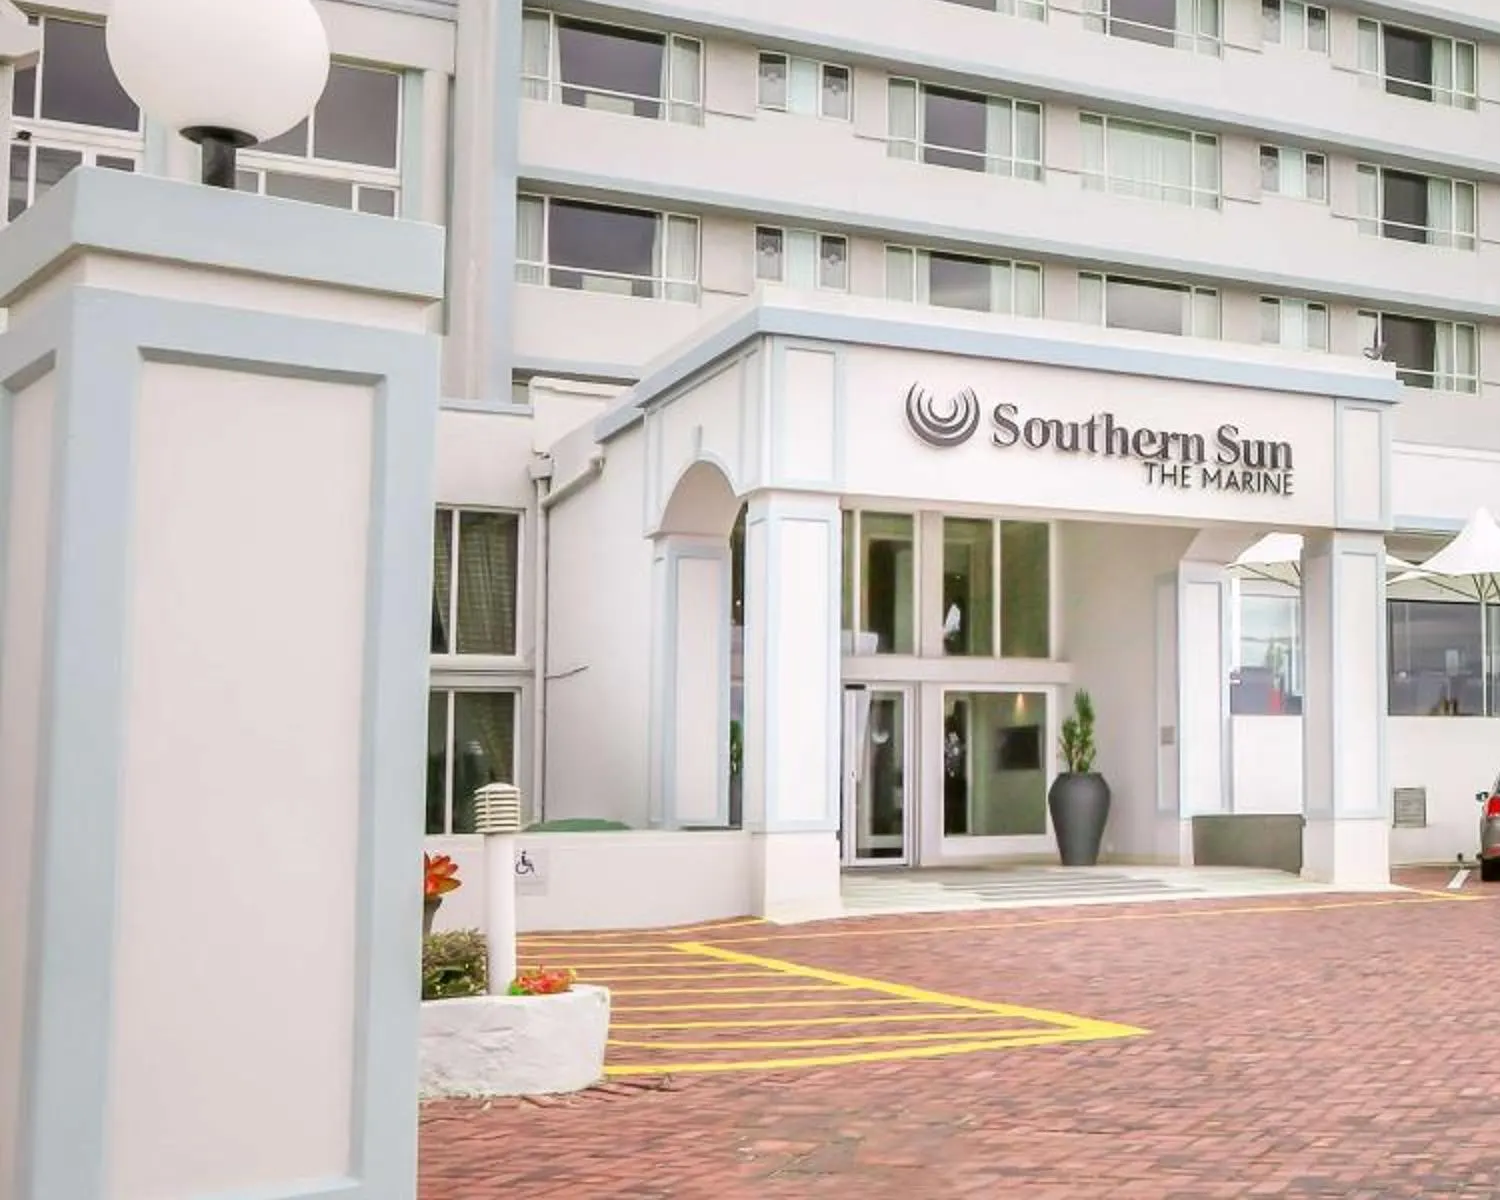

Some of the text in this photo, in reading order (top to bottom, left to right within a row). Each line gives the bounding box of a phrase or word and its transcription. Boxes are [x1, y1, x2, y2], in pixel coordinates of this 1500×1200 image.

[993, 403, 1293, 468] Southern Sun
[1146, 461, 1294, 495] THE MARINE
